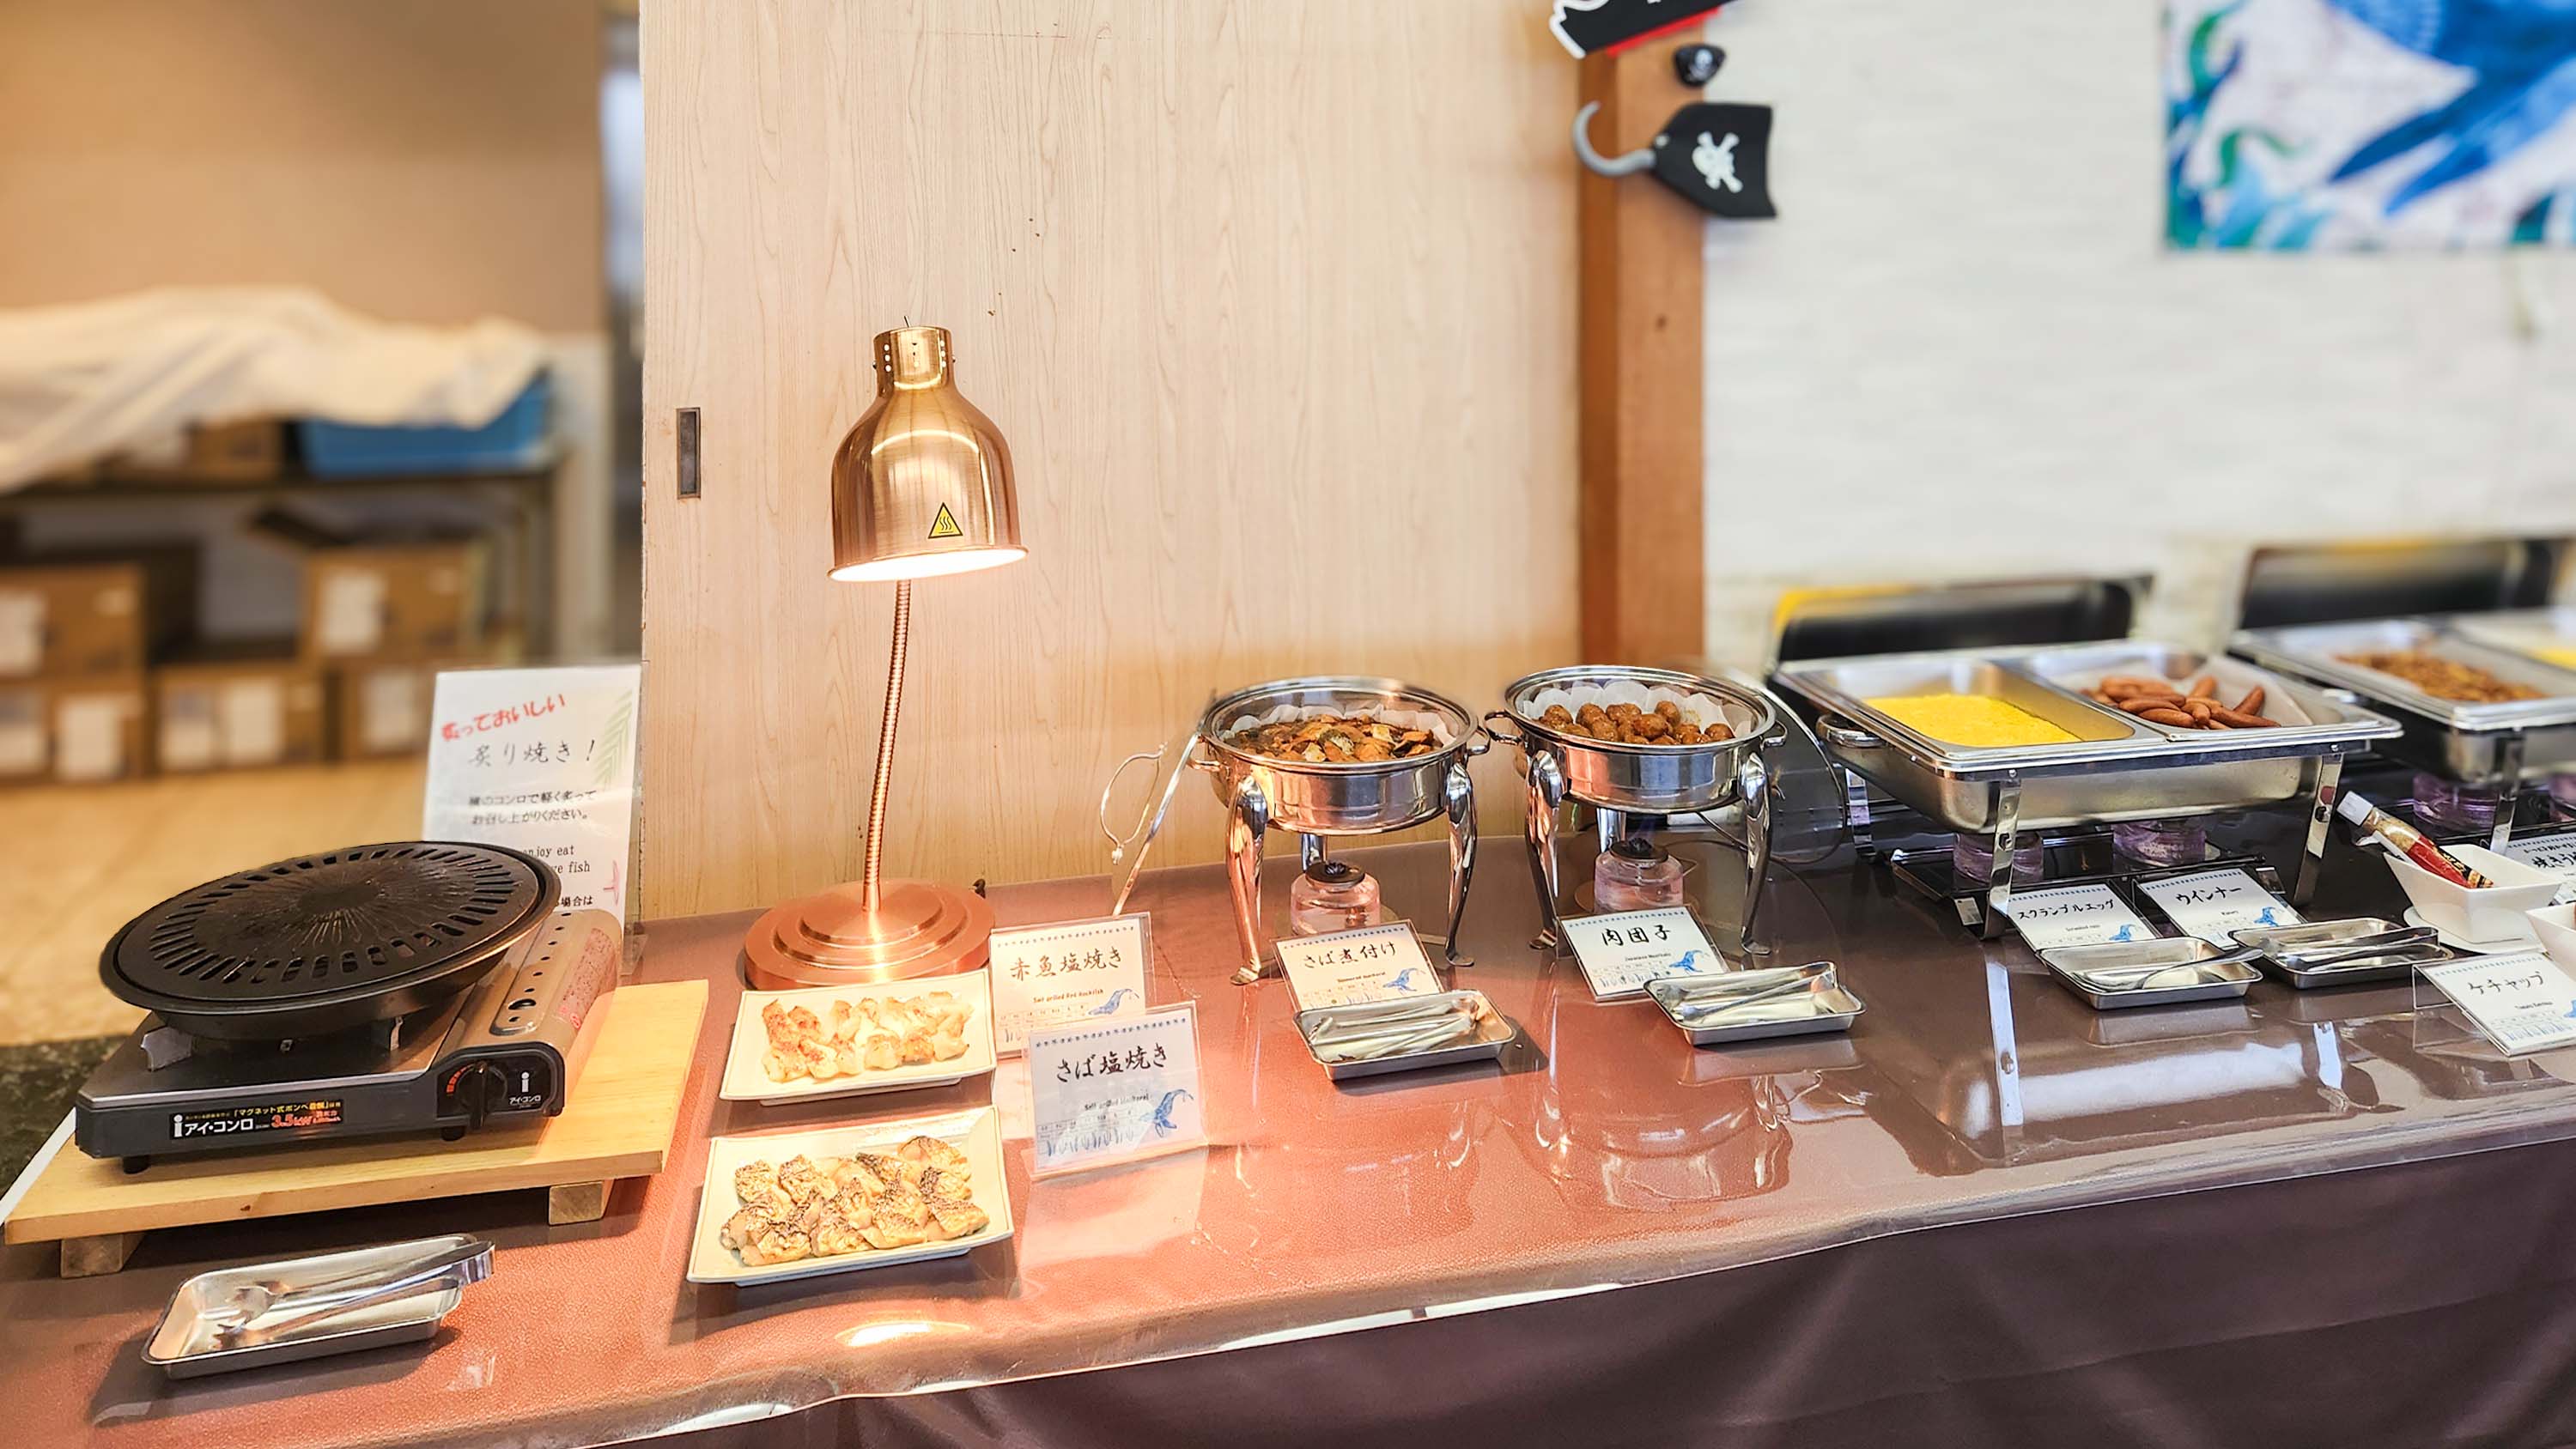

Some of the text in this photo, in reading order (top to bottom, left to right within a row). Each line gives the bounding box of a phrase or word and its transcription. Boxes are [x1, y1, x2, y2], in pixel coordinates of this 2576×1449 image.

[556, 844, 574, 856] eat
[568, 860, 591, 873] fish
[1601, 924, 1672, 947] 肉団子
[1010, 945, 1122, 982] 赤魚塩焼き
[1302, 941, 1396, 969] さば煮付け
[1057, 1042, 1168, 1082] さば塩焼き
